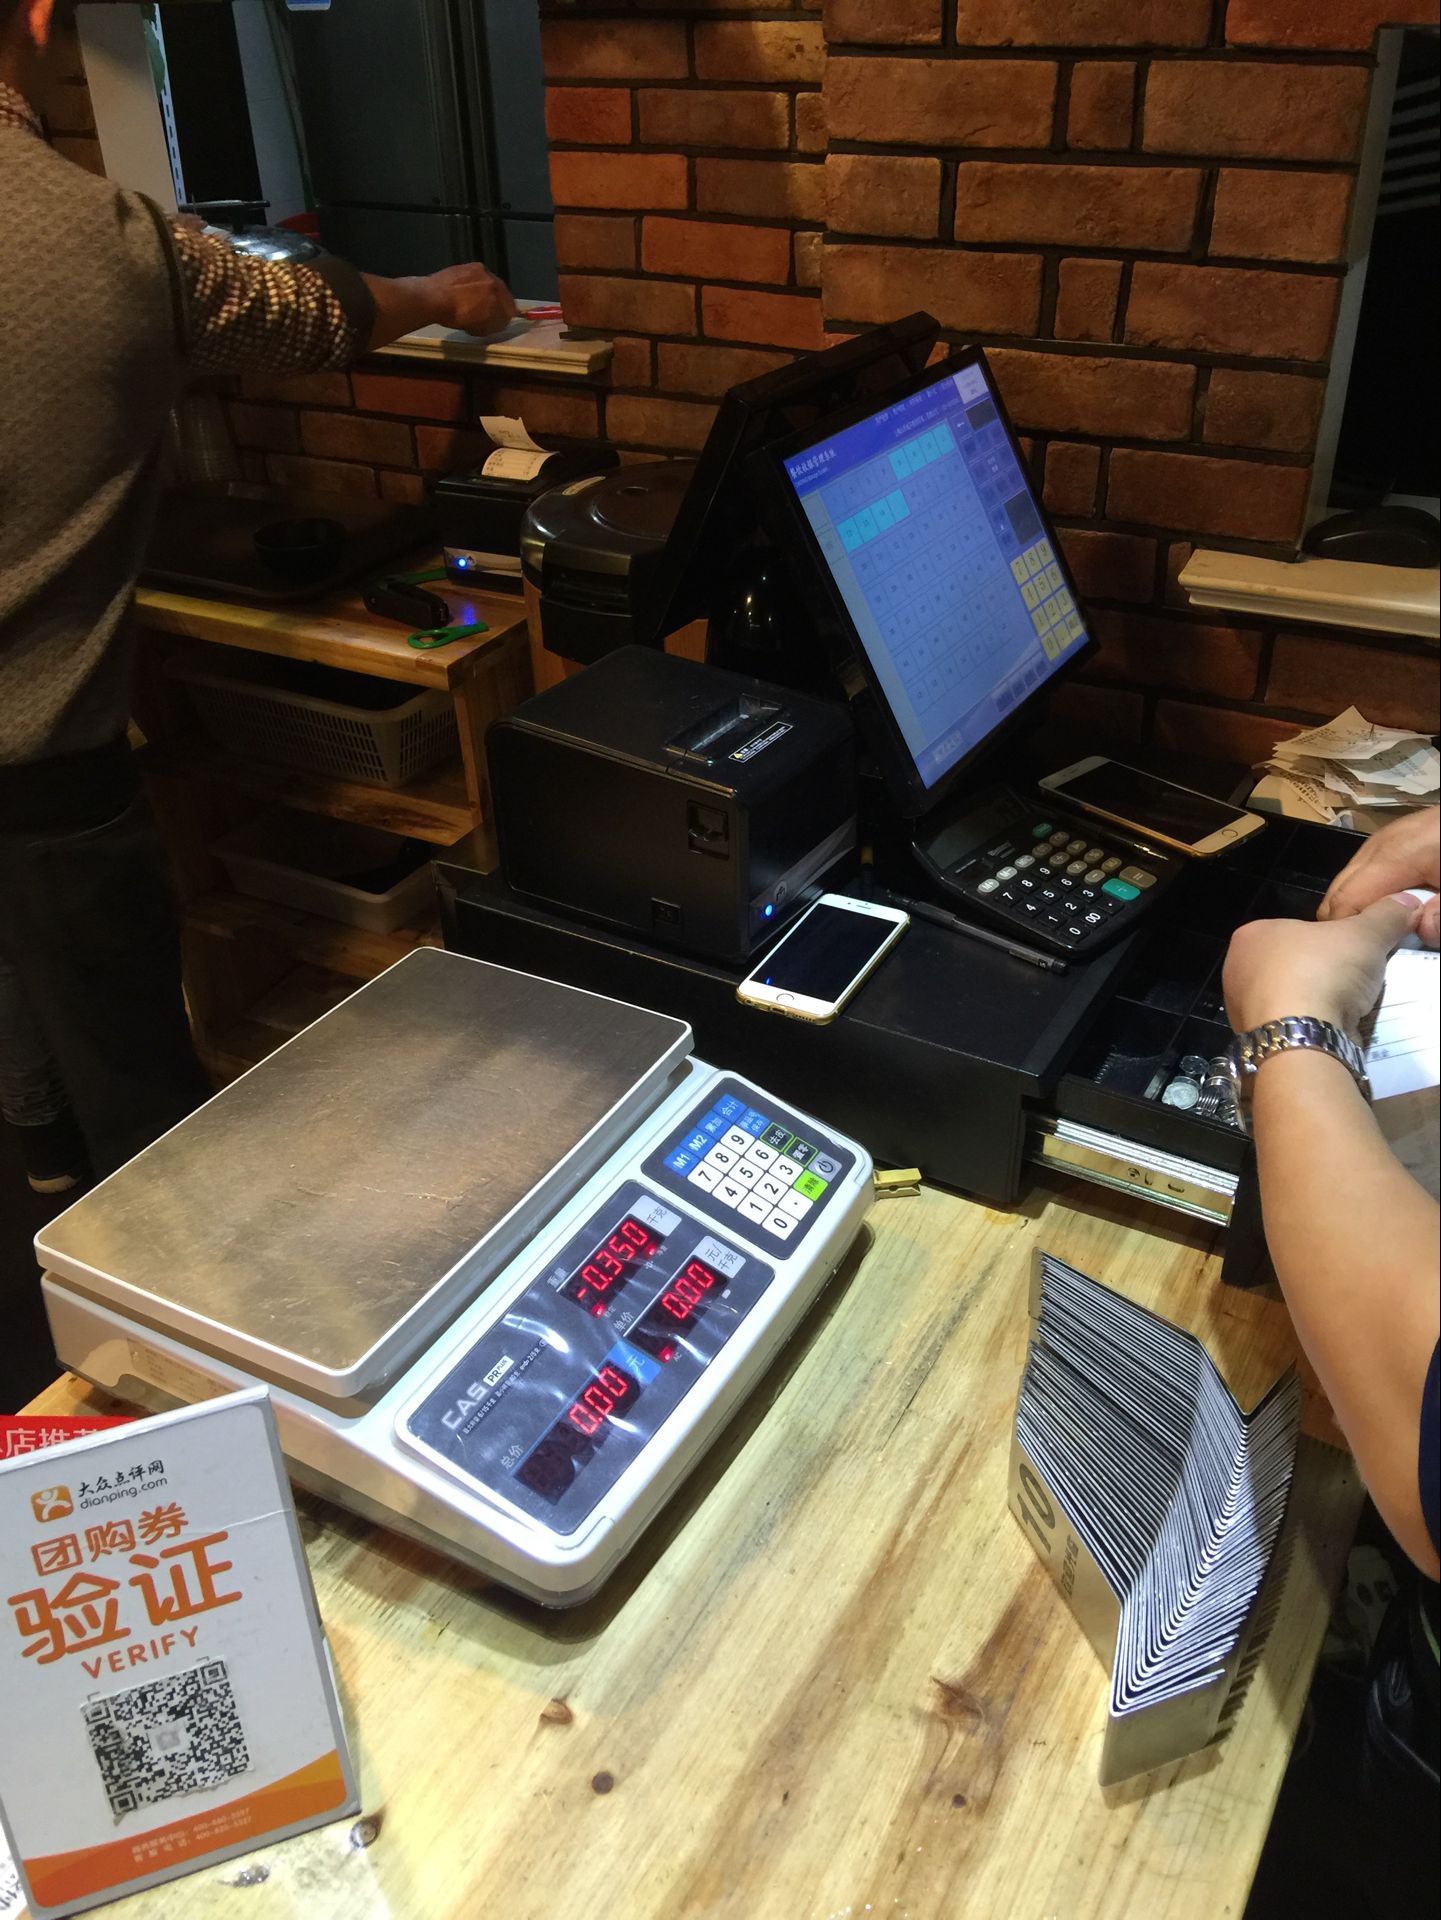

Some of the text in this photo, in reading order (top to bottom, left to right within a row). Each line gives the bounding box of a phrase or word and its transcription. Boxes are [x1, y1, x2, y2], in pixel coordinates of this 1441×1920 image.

[1002, 867, 1051, 900] 7 8 9
[1026, 903, 1036, 911] 4
[1042, 890, 1055, 898] 5
[1065, 902, 1077, 911] 2
[1082, 890, 1095, 898] 3
[1069, 912, 1101, 935] 0 00
[673, 1153, 690, 1169] M1
[689, 1135, 708, 1151] M2
[722, 1100, 738, 1116] 合计
[698, 1170, 711, 1181] 7
[715, 1152, 729, 1163] 8
[731, 1135, 745, 1145] 9
[725, 1129, 786, 1197] 4 5 6 去皮
[749, 1202, 763, 1211] 1
[764, 1183, 779, 1195] 2
[779, 1164, 793, 1175] 3
[646, 1206, 668, 1224] 千克
[774, 1218, 787, 1228] 0
[718, 1252, 738, 1270] 千克
[661, 1263, 715, 1319] 0.00
[614, 1310, 635, 1331] 单价
[626, 1354, 645, 1373] 元
[441, 1382, 489, 1430] CAS
[569, 1367, 628, 1434] 0.00
[0, 1428, 100, 1458] 店推
[500, 1444, 524, 1471] 总价
[78, 1460, 164, 1497] 大众点评网
[80, 1477, 168, 1509] dianping.com
[1017, 1463, 1055, 1554] 10
[31, 1502, 189, 1577] 团购券
[8, 1531, 243, 1665] 验证
[81, 1626, 199, 1679] VERIFY
